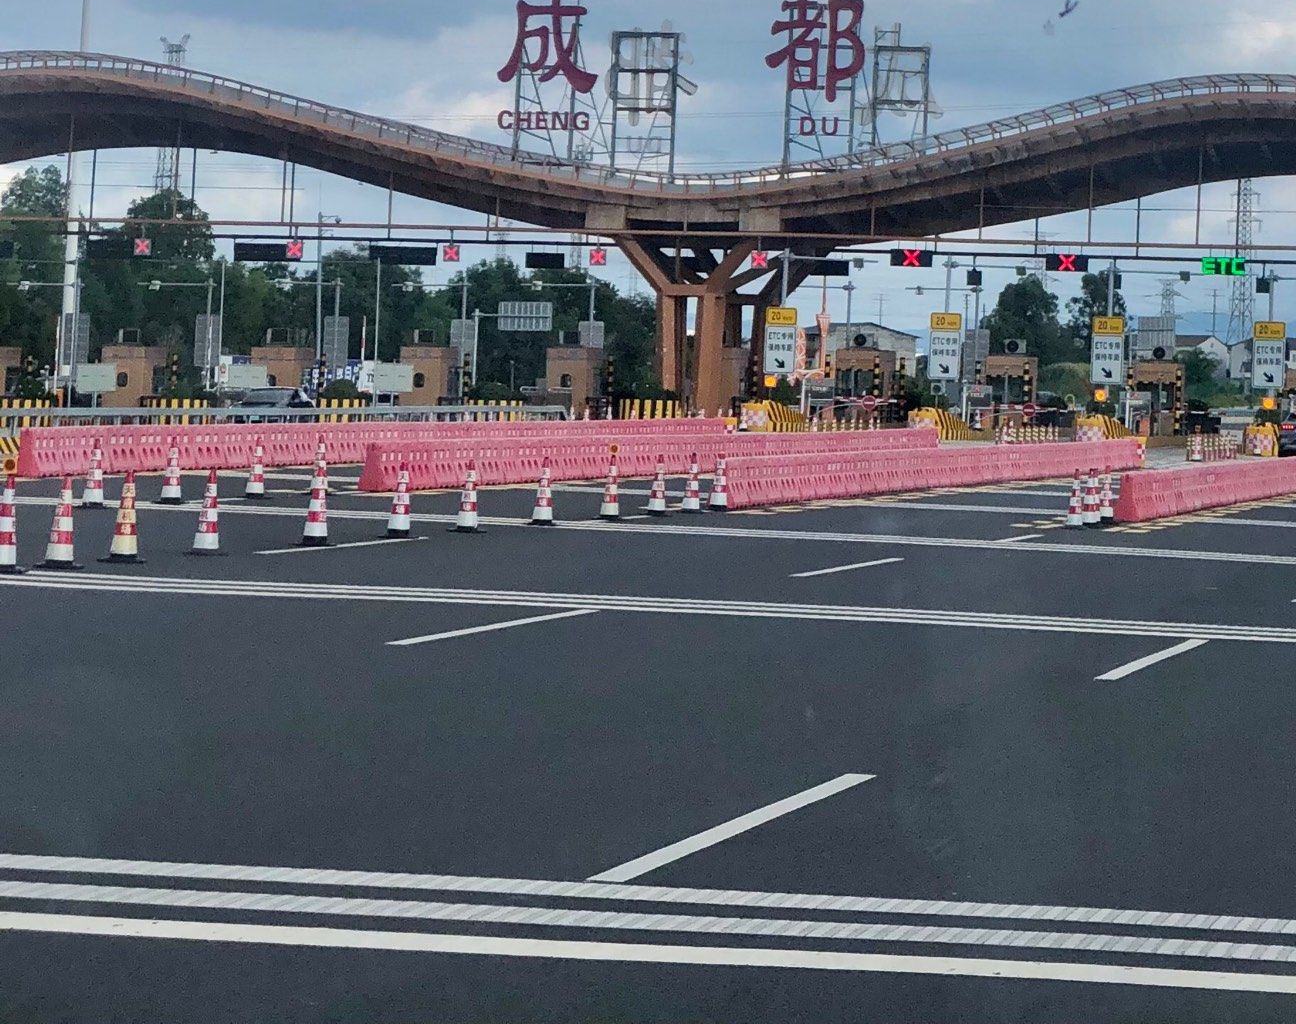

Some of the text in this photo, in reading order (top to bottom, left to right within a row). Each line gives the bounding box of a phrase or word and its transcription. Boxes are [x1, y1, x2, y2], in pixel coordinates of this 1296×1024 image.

[497, 109, 839, 136] CHENG DU
[1202, 257, 1245, 275] ETC
